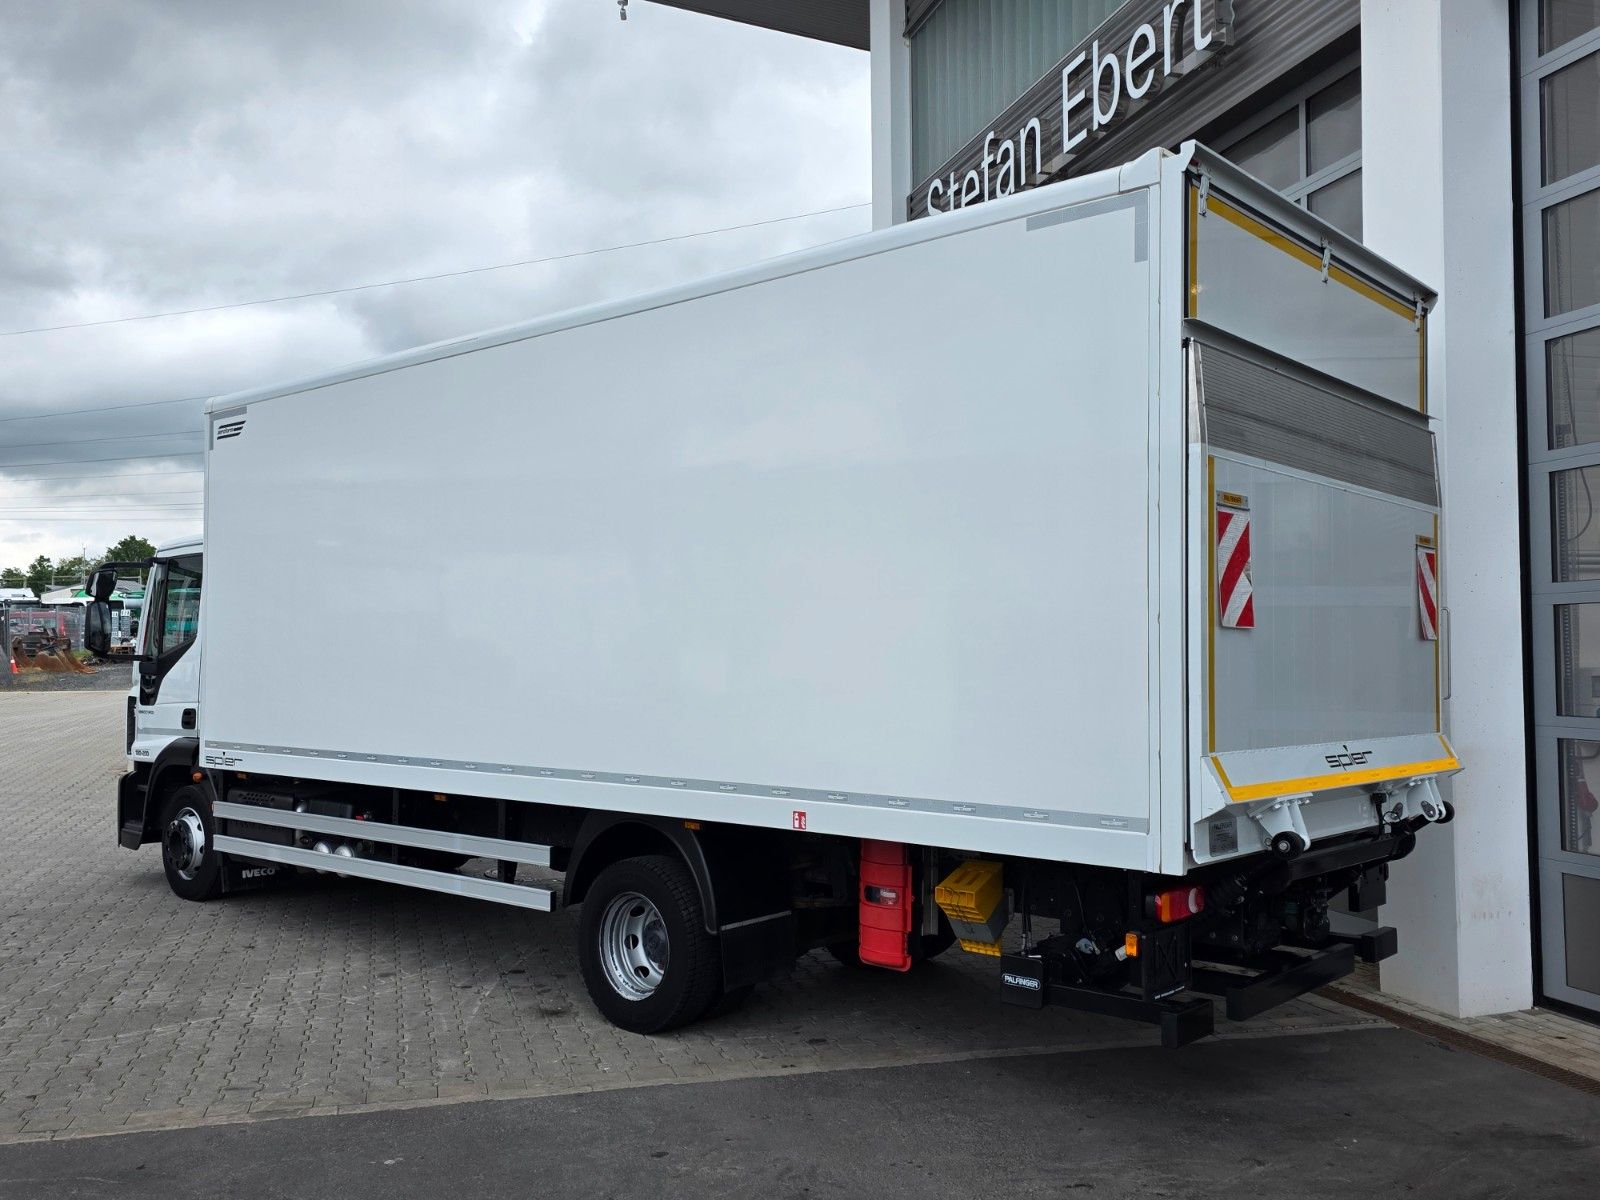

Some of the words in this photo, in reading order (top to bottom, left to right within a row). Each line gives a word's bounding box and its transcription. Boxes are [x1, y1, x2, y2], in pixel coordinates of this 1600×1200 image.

[927, 117, 1042, 216] Stefan
[205, 751, 243, 767] spier
[1325, 744, 1373, 772] spier
[241, 867, 276, 879] IVECO
[1003, 974, 1040, 989] PALFINGER
